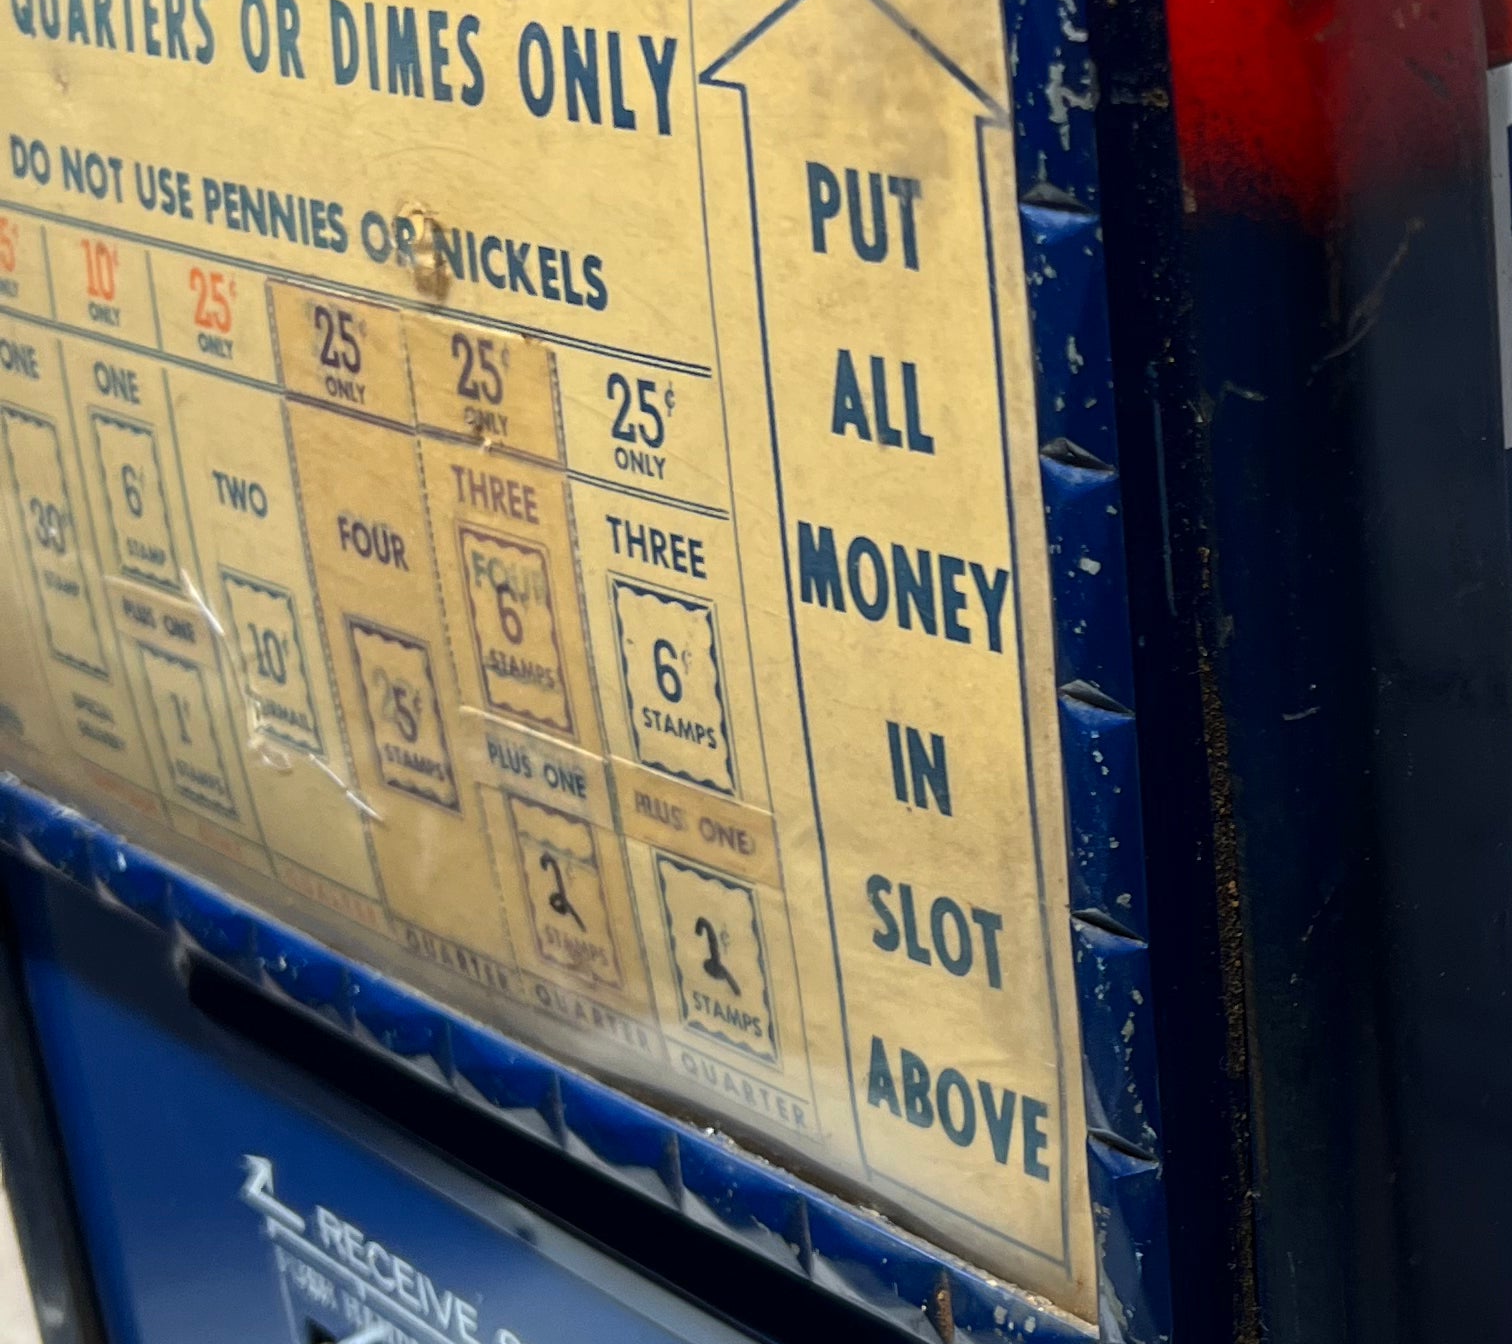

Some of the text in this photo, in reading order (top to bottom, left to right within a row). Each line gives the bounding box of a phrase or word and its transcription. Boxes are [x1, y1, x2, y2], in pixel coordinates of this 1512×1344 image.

[518, 21, 678, 136] ONLY
[10, 133, 609, 311] DO NOT USE PENNIES OR NICKELS
[805, 160, 921, 273] PUT
[93, 360, 140, 405] ONE
[325, 375, 366, 404] ONLY
[607, 372, 675, 449] 25¢
[831, 348, 935, 456] ALL
[463, 406, 508, 437] ONLY
[212, 469, 268, 518] TWO
[451, 465, 540, 525] THREE
[615, 447, 666, 480] ONLY
[337, 515, 409, 571] FOUR
[606, 514, 707, 579] THREE
[799, 521, 1010, 654] MONEY
[642, 707, 718, 750] STAMPS
[487, 734, 587, 799] PLUS ONE
[886, 720, 953, 817] IN
[699, 817, 751, 854] ONE
[867, 873, 1004, 991] SLOT
[693, 991, 763, 1038] STAMPS
[866, 1035, 1051, 1182] ABOVE
